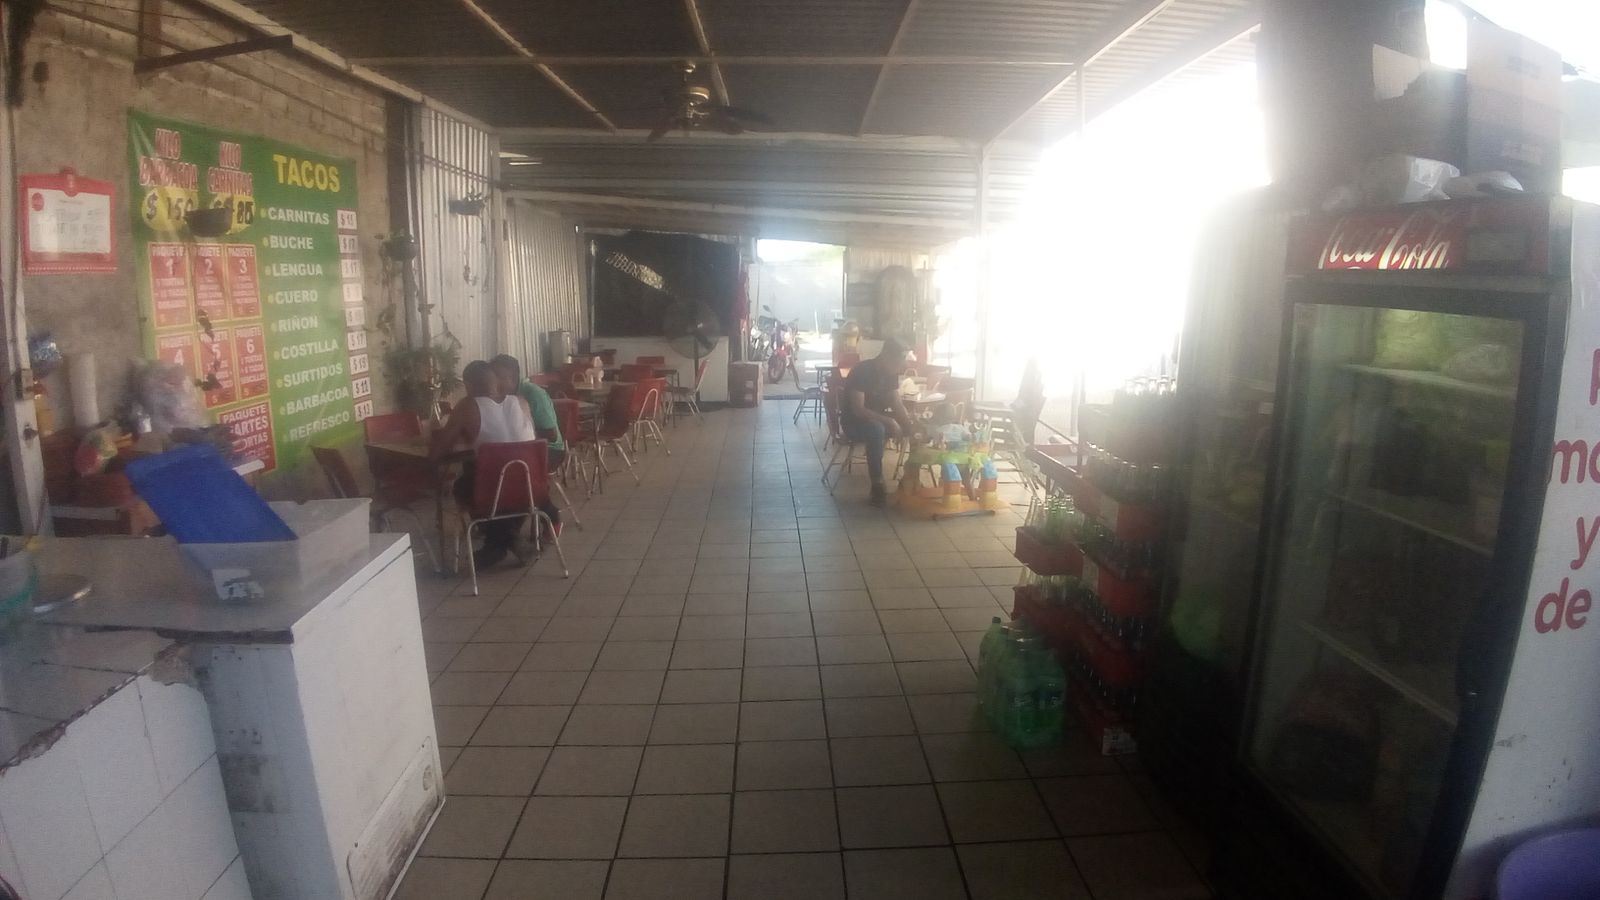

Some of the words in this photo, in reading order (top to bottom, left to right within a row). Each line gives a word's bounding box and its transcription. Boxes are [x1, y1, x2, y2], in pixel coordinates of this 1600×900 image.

[273, 154, 340, 192] TACOS
[267, 207, 330, 225] CARNITAS
[269, 235, 314, 250] BUCHE
[165, 258, 174, 275] 1
[205, 258, 215, 275] 2
[239, 258, 248, 274] 3
[272, 263, 324, 277] LENGUA
[275, 290, 318, 304] CUERO
[245, 338, 255, 354] 6
[281, 339, 339, 360] COSTILLA
[174, 348, 185, 366] 4
[283, 363, 343, 388] SURTIDOS
[286, 386, 349, 415] BARBACOA
[223, 404, 267, 424] PAQUETE
[289, 411, 349, 442] REFRESCO
[1534, 577, 1592, 634] de
